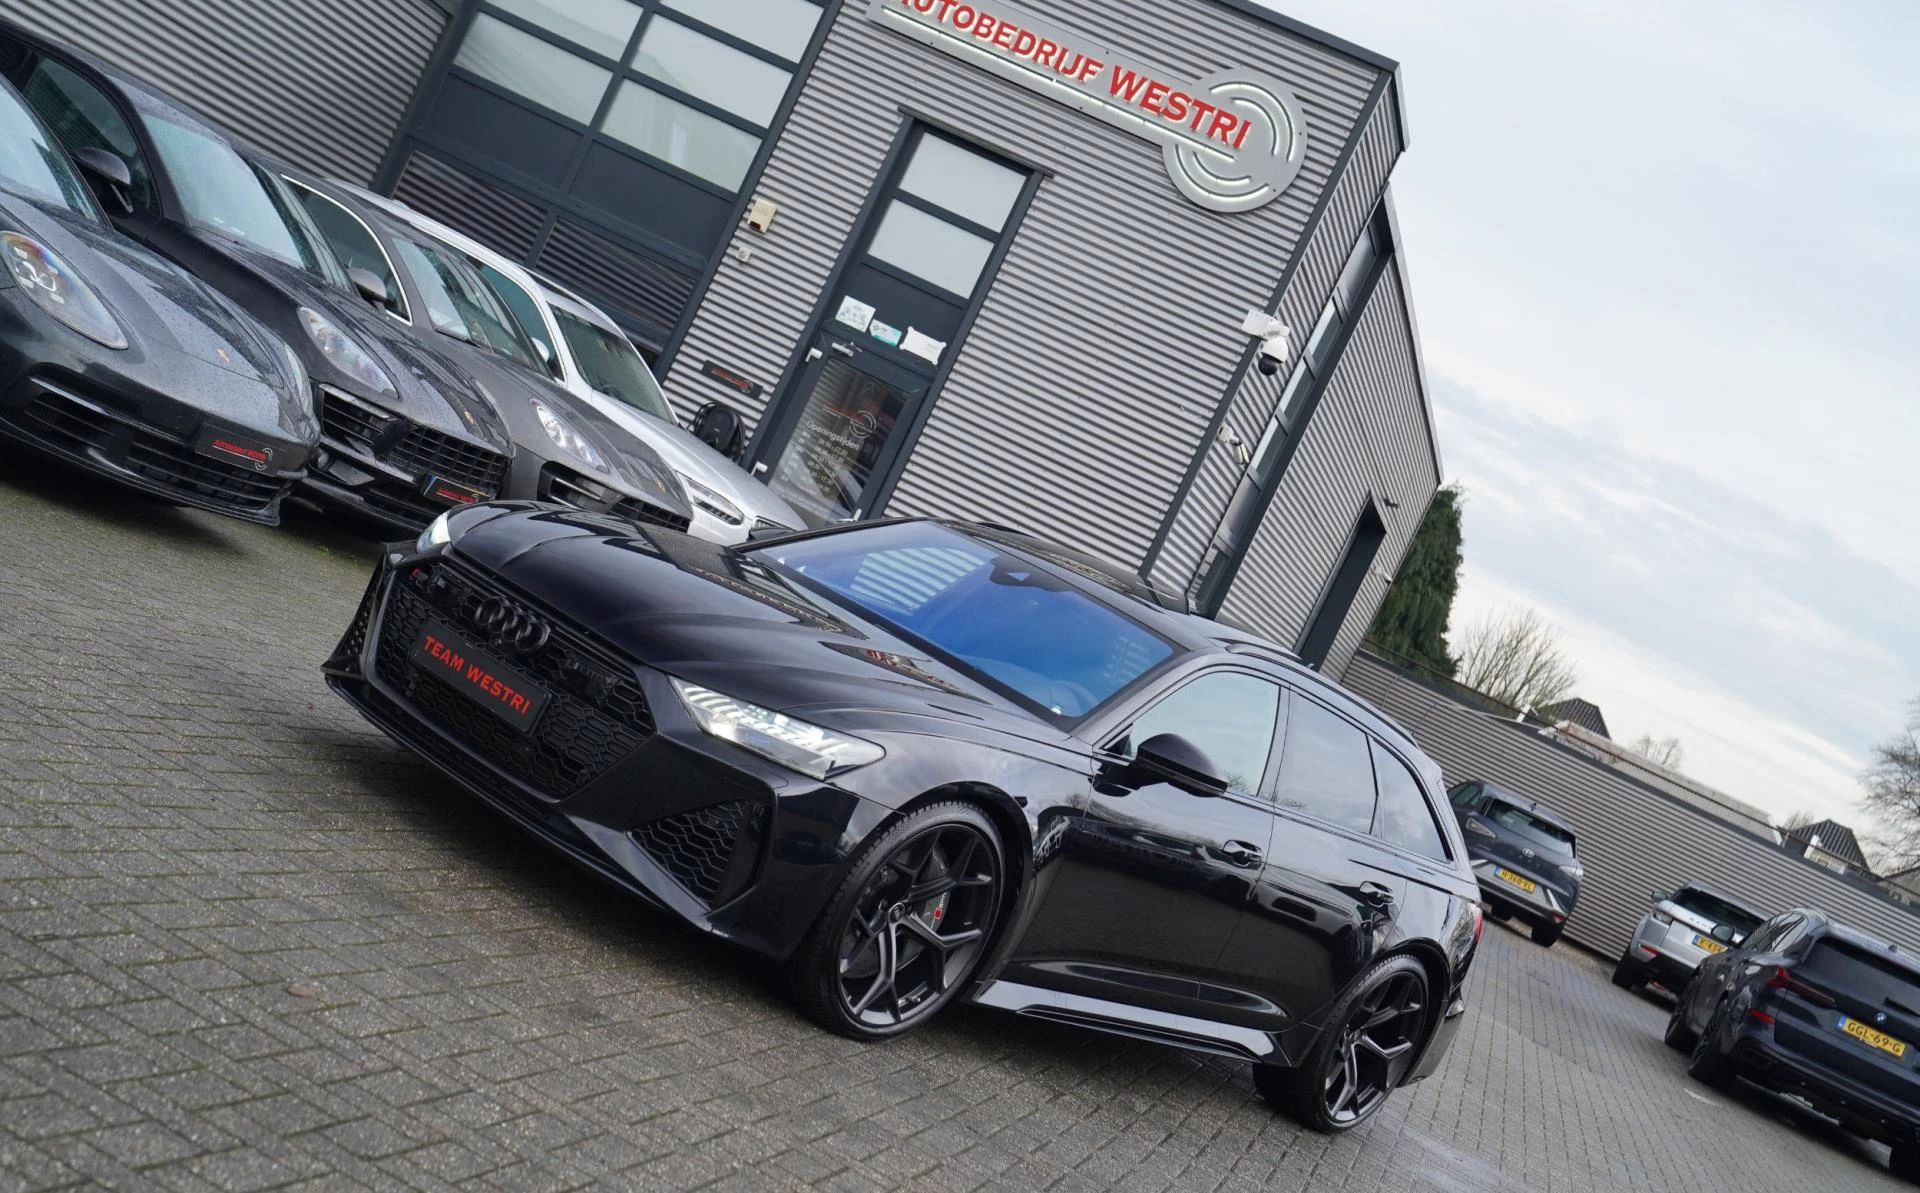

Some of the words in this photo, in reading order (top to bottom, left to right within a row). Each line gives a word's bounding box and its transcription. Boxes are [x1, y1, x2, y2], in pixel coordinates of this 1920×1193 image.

[901, 0, 1105, 82] UTOBEDRIJF
[1109, 64, 1252, 150] WESTRI
[806, 420, 860, 450] Openingstijden
[423, 635, 466, 673] TEAM
[465, 664, 531, 715] WESTRI
[1847, 1021, 1902, 1053] GGL-69-G
